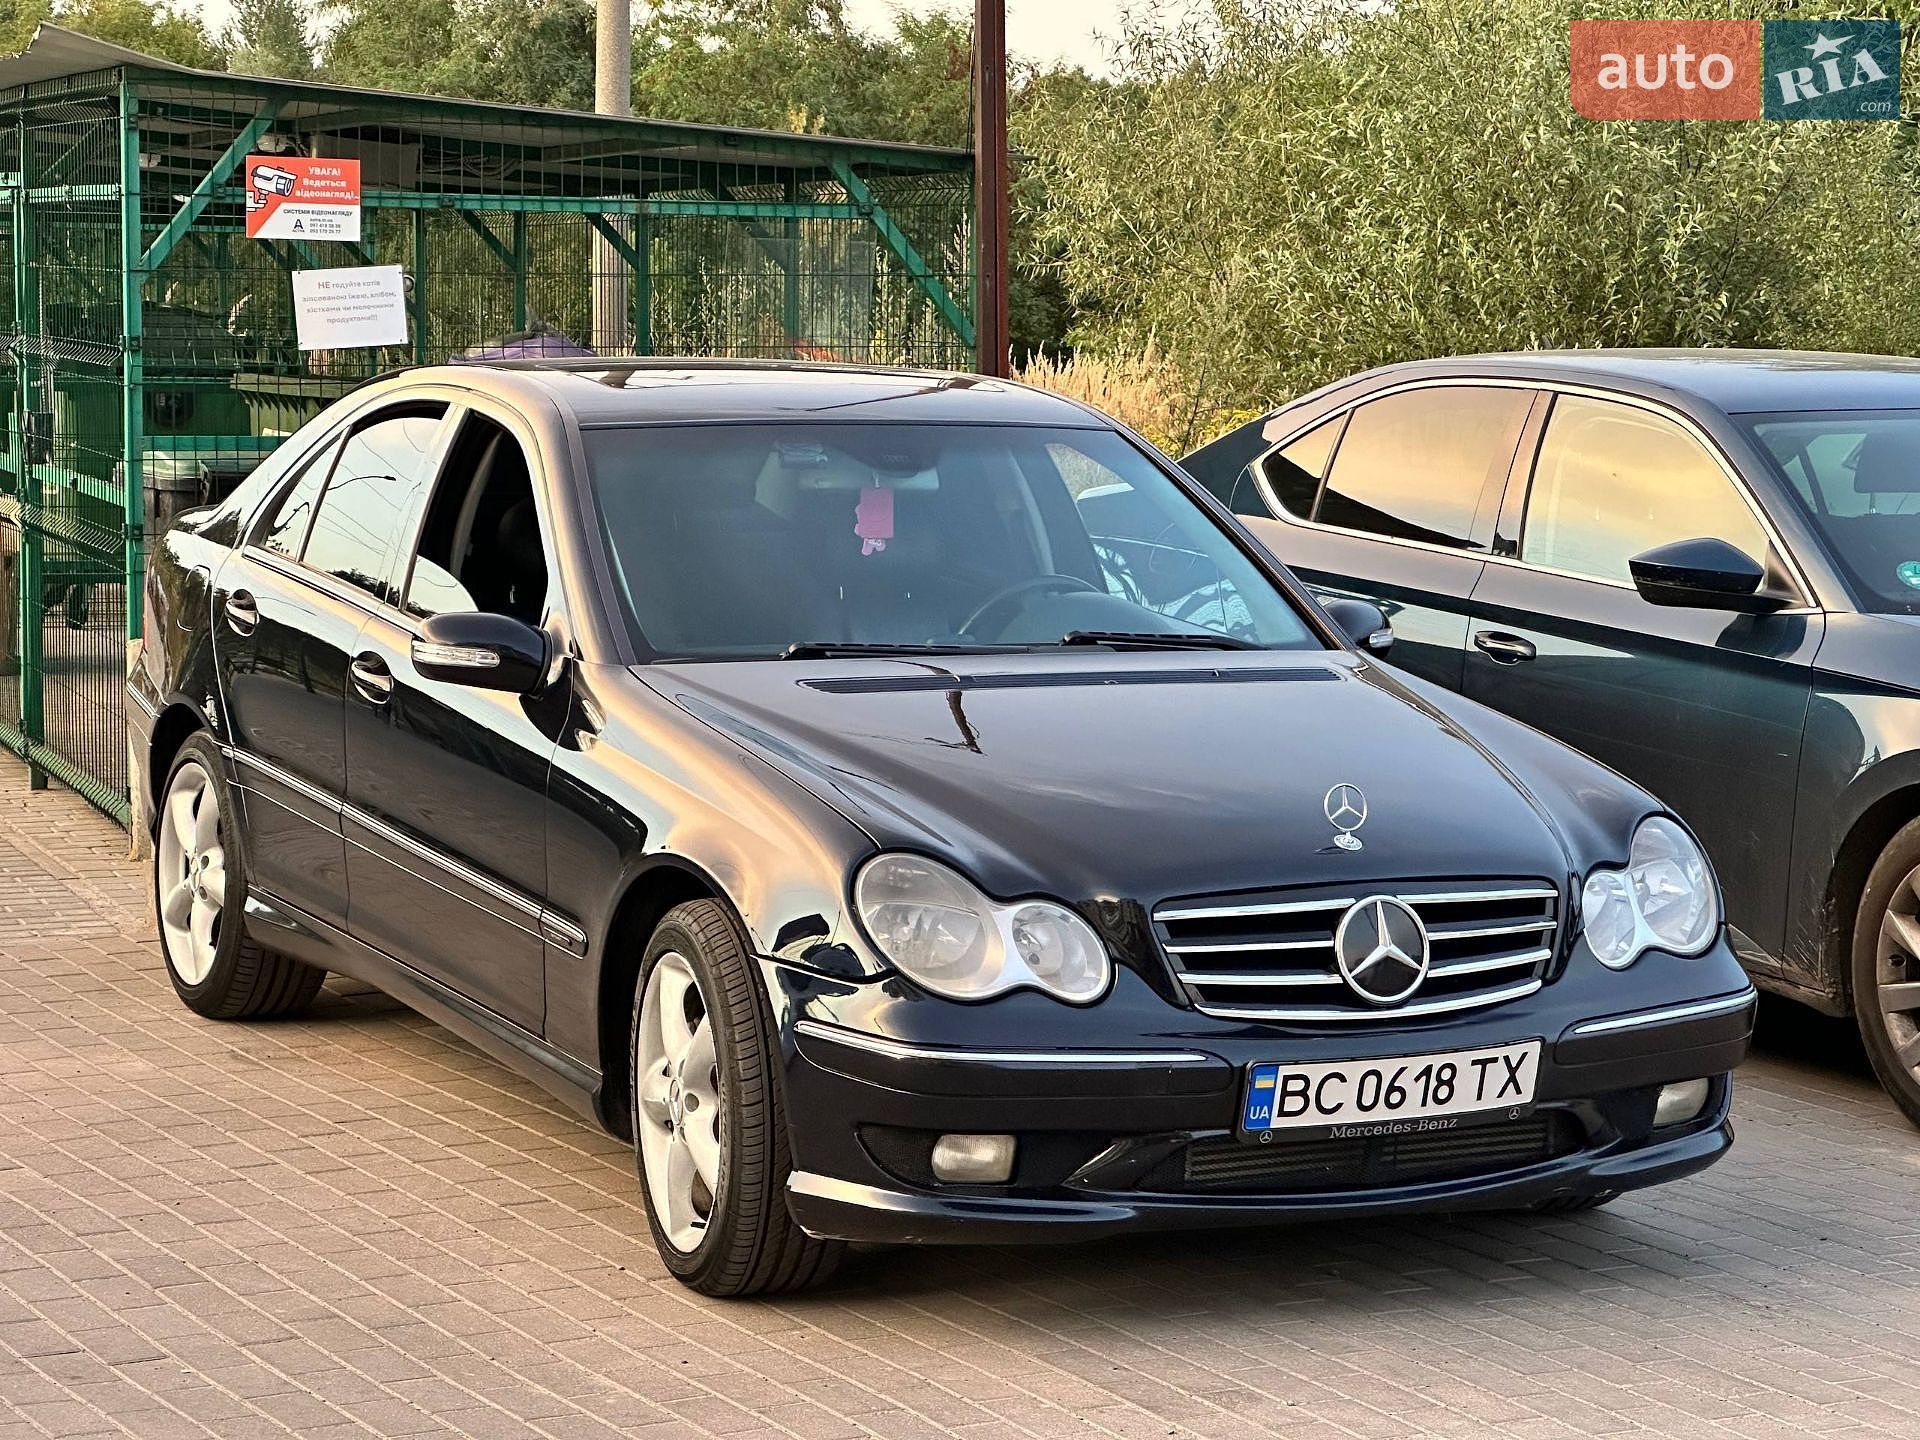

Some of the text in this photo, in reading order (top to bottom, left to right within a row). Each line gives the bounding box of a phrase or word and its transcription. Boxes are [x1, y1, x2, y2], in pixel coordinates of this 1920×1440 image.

[308, 166, 341, 176] УВАГА!
[302, 178, 347, 188] Ведеться
[317, 281, 331, 289] НЕ
[332, 281, 361, 289] годуйте
[1277, 1051, 1529, 1118] BC 0618 TX
[1249, 1104, 1270, 1120] UA
[1329, 1117, 1459, 1140] Mercedes-Benz
